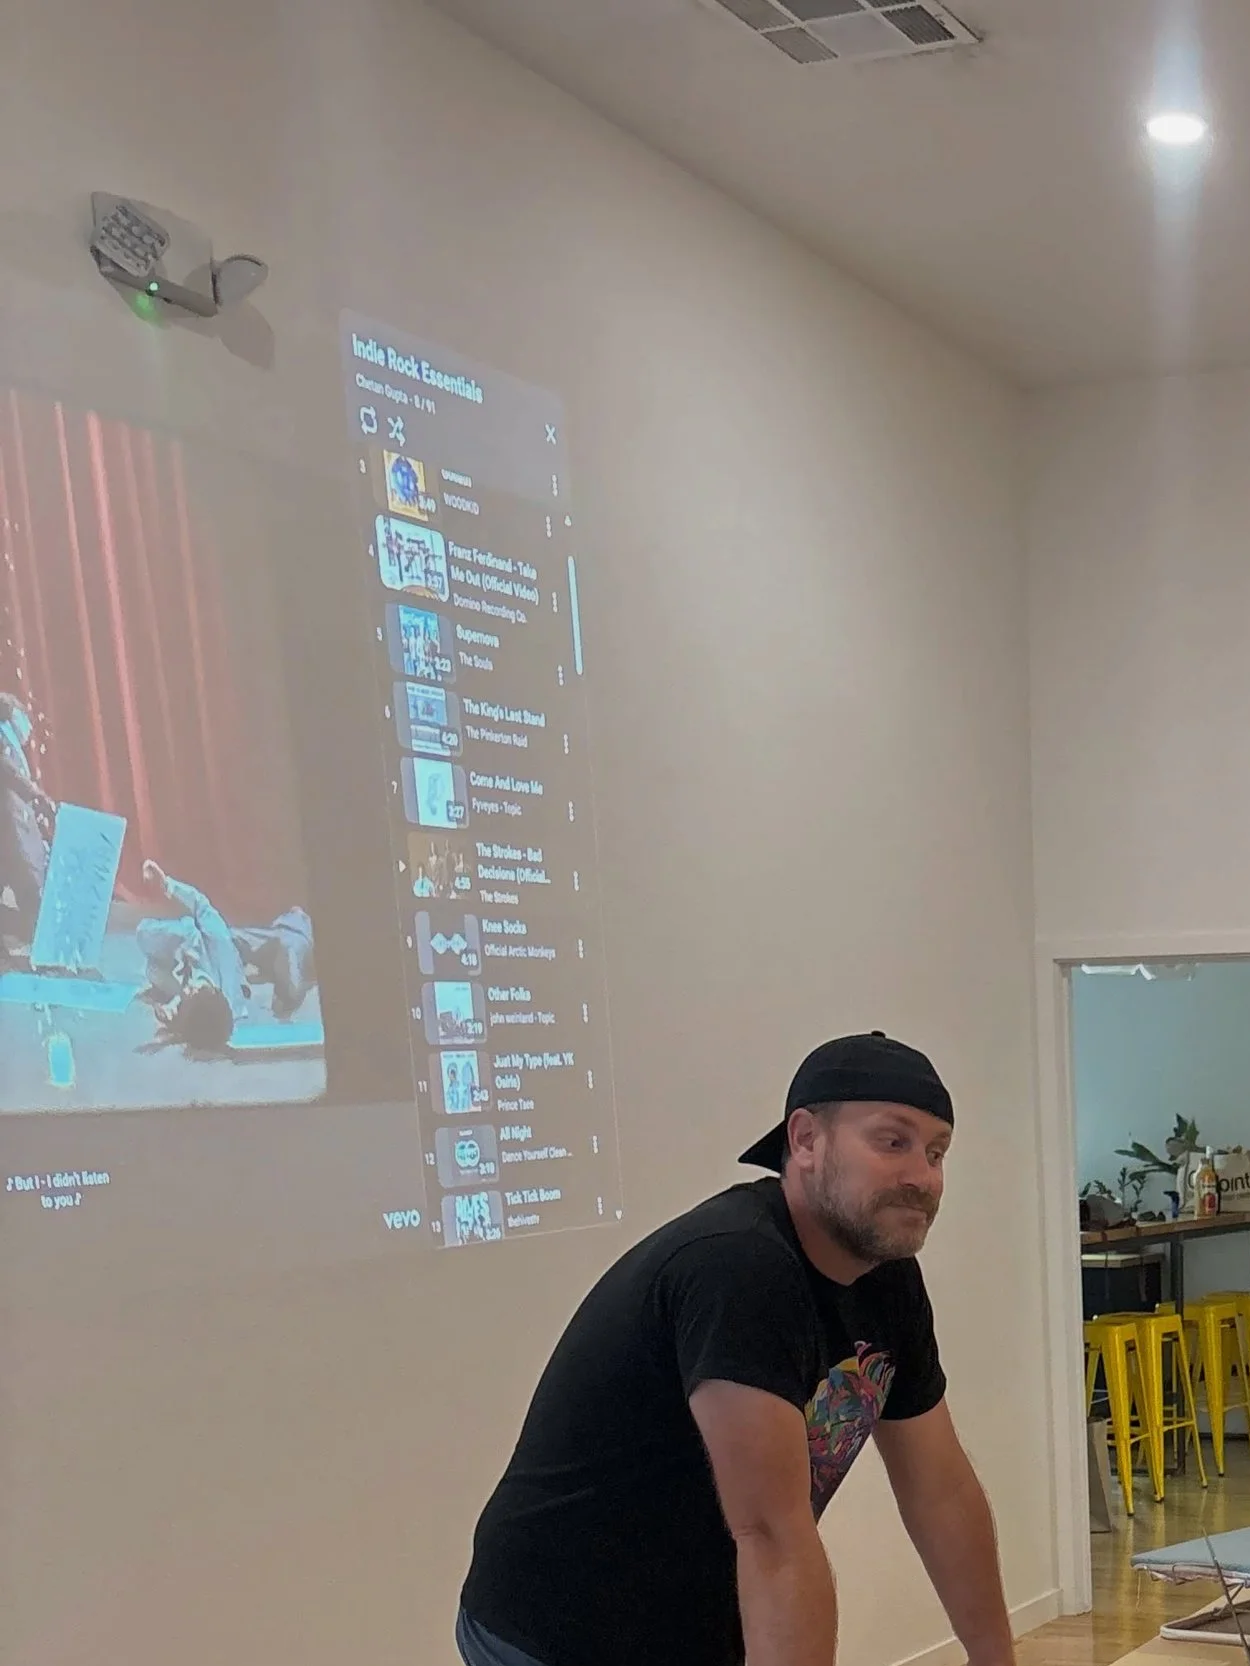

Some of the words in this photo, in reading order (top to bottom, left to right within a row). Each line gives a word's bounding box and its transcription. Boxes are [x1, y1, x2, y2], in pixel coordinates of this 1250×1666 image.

[352, 333, 385, 367] Indie
[387, 347, 420, 380] Rock
[421, 360, 483, 404] Essentials
[448, 541, 471, 562] Franz
[472, 548, 513, 574] Ferdinand
[517, 561, 537, 581] Take
[451, 568, 465, 582] Me
[466, 572, 481, 588] Out
[482, 572, 513, 596] (Official
[513, 583, 540, 606] Video)
[453, 593, 480, 611] Domino
[481, 602, 515, 624] Recording
[455, 623, 500, 648] Supernova
[458, 651, 473, 667] The
[463, 697, 479, 715] The
[480, 701, 503, 722] King's
[504, 706, 522, 724] Last
[523, 710, 546, 728] Stand
[466, 725, 480, 740] The
[470, 771, 493, 789] Come
[494, 775, 511, 792] And
[511, 779, 531, 794] Love
[531, 781, 543, 796] Me
[503, 801, 522, 817] Topic
[476, 842, 492, 858] The
[493, 844, 522, 862] Strokes
[527, 847, 543, 863] Bad
[477, 864, 515, 883] Decisions
[480, 890, 493, 904] The
[494, 891, 519, 905] Strokes
[482, 919, 502, 934] Knee
[503, 920, 527, 935] Socks
[484, 943, 506, 957] Official
[507, 945, 527, 958] Arctic
[527, 946, 556, 961] Monkeys
[487, 986, 509, 1002] Other
[510, 987, 532, 1002] Folks
[537, 1011, 555, 1027] Topic
[494, 1054, 511, 1068] Just
[511, 1053, 524, 1069] My
[524, 1053, 543, 1070] Type
[418, 1081, 428, 1093] 11
[497, 1098, 518, 1112] Prince
[500, 1126, 511, 1141] All
[511, 1125, 532, 1142] Night
[425, 1153, 435, 1165] 12
[501, 1150, 522, 1163] Dance
[523, 1148, 548, 1162] Yourself
[549, 1147, 567, 1159] Clean
[15, 1175, 34, 1191] But
[53, 1171, 81, 1188] didn't
[82, 1171, 110, 1185] listen
[41, 1194, 52, 1208] to
[54, 1194, 73, 1210] you
[504, 1190, 523, 1206] Tick
[522, 1189, 539, 1204] Tick
[539, 1188, 561, 1202] Boom
